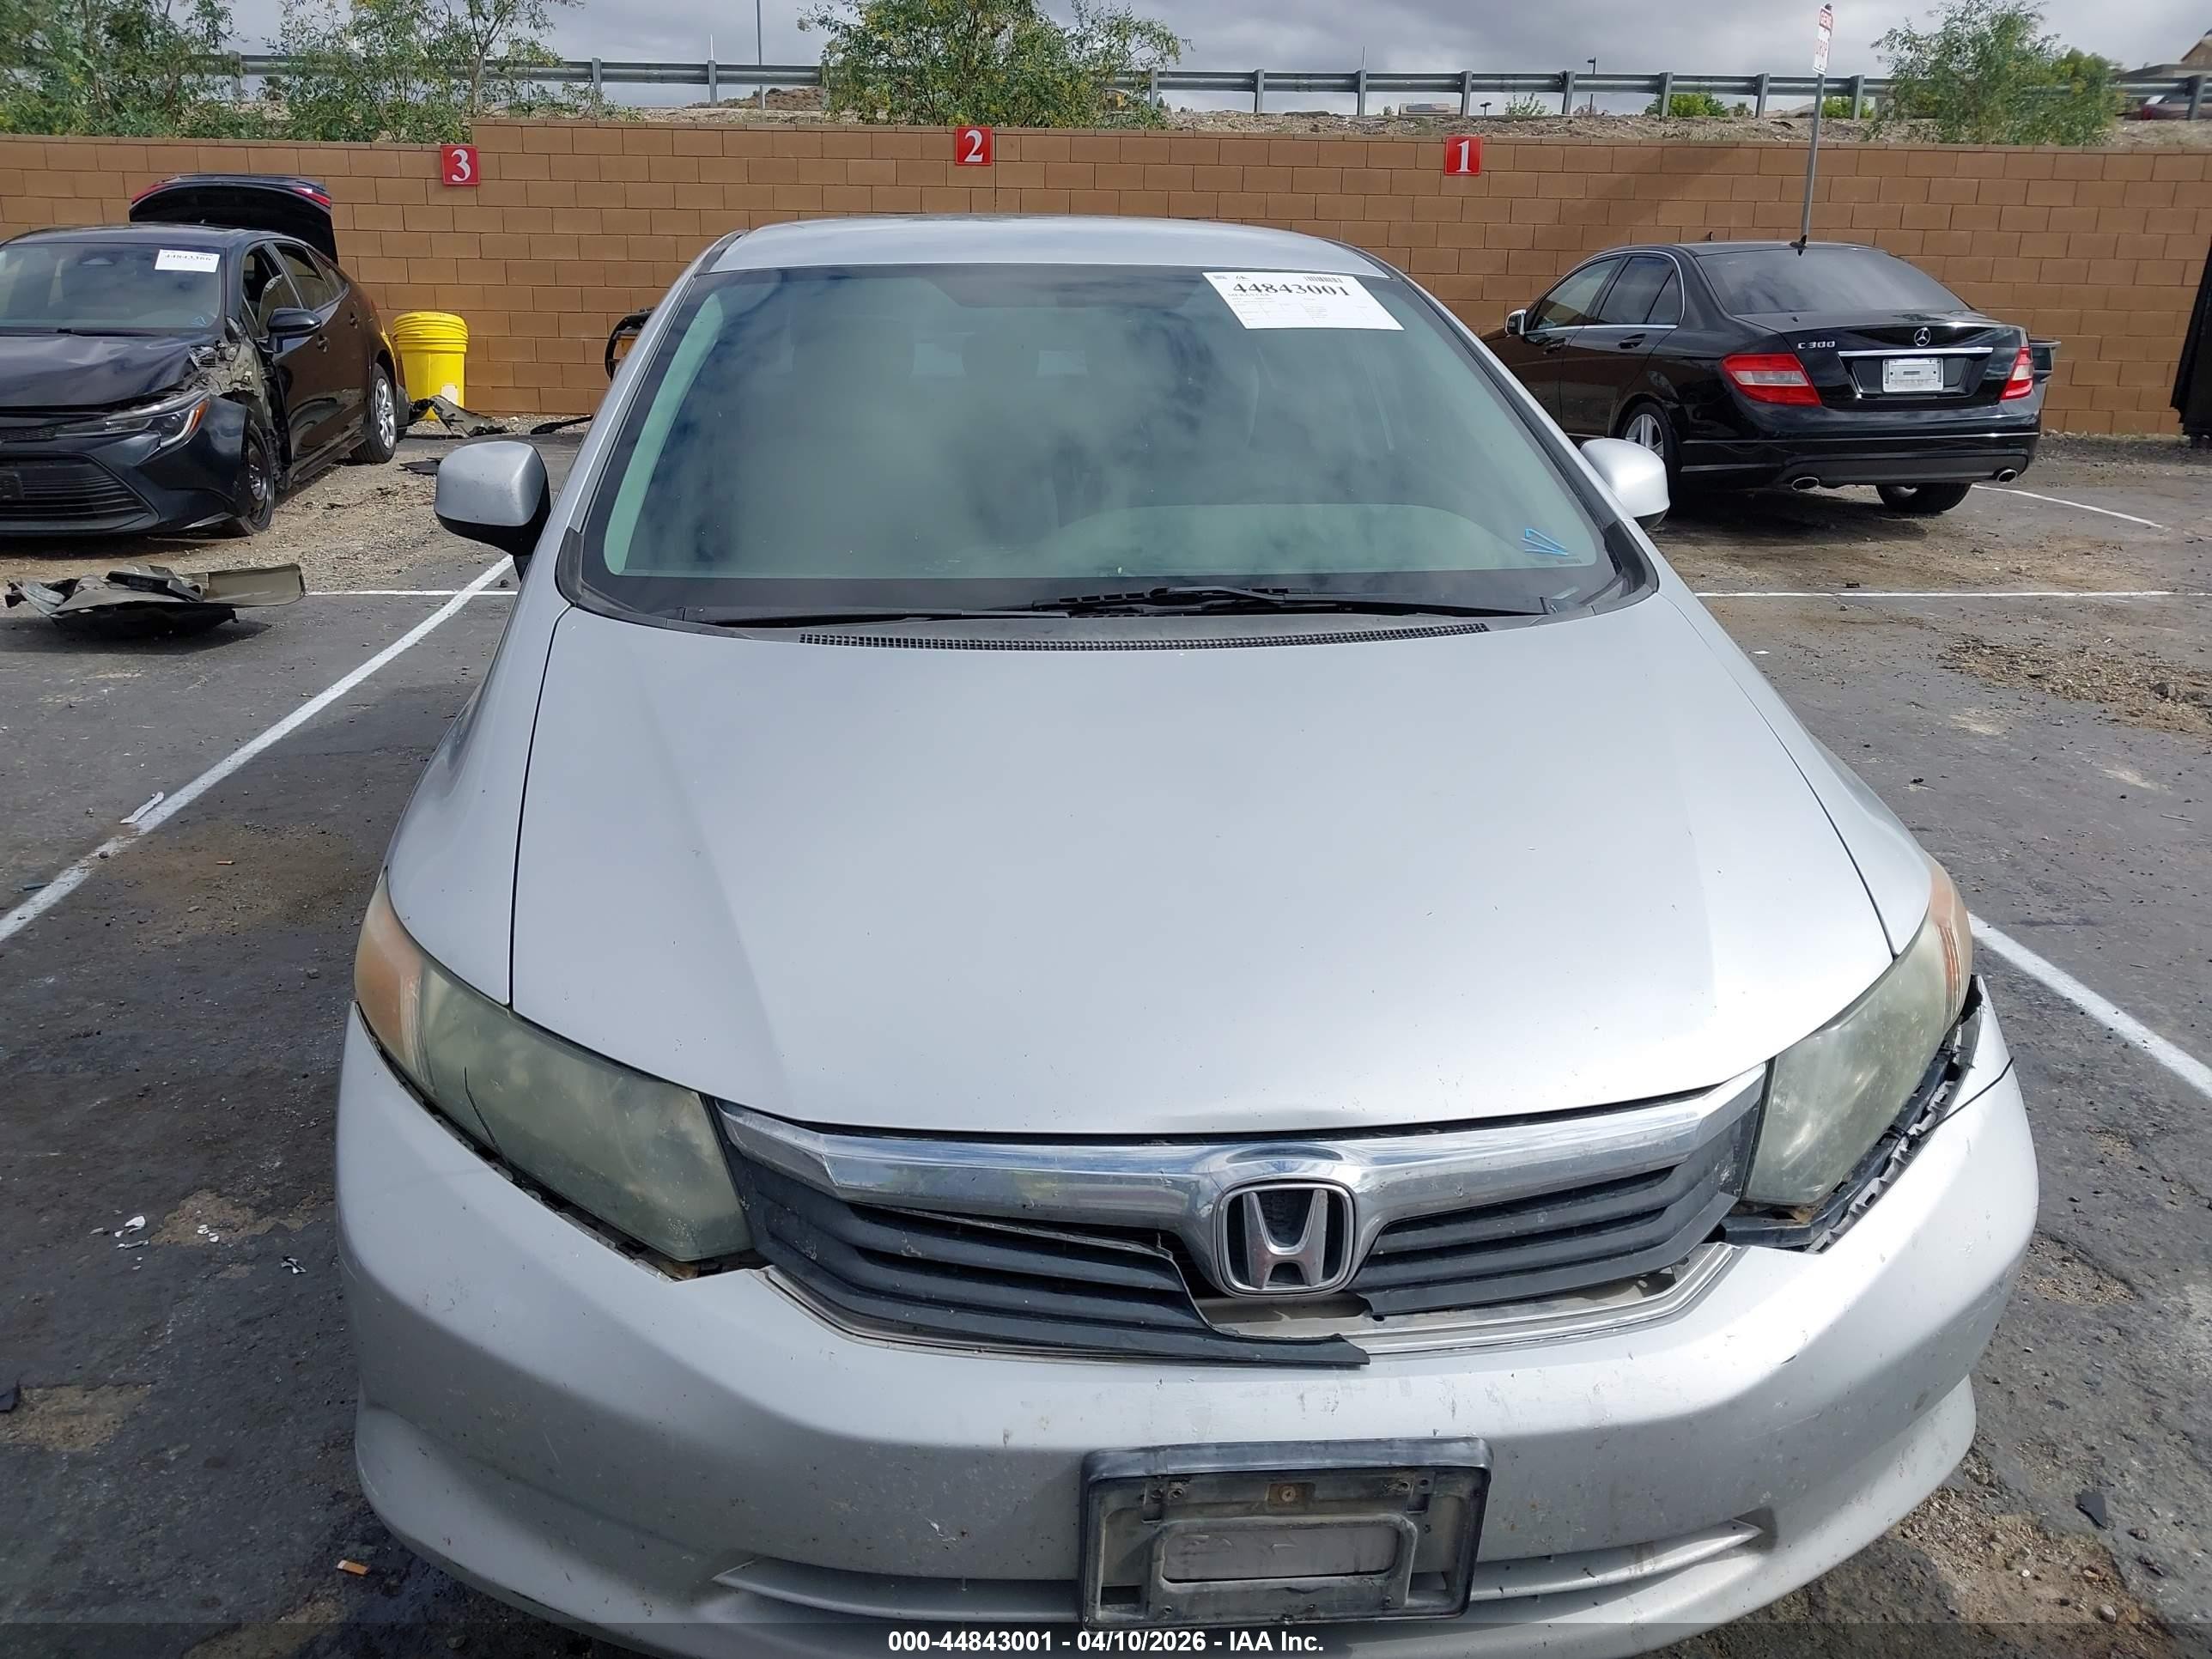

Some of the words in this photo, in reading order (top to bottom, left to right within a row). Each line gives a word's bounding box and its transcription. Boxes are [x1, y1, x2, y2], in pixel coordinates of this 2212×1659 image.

[964, 130, 983, 162] 2
[1456, 140, 1472, 172] 1
[452, 149, 471, 181] 3
[1233, 283, 1351, 296] 44843001
[1808, 340, 1835, 349] 300
